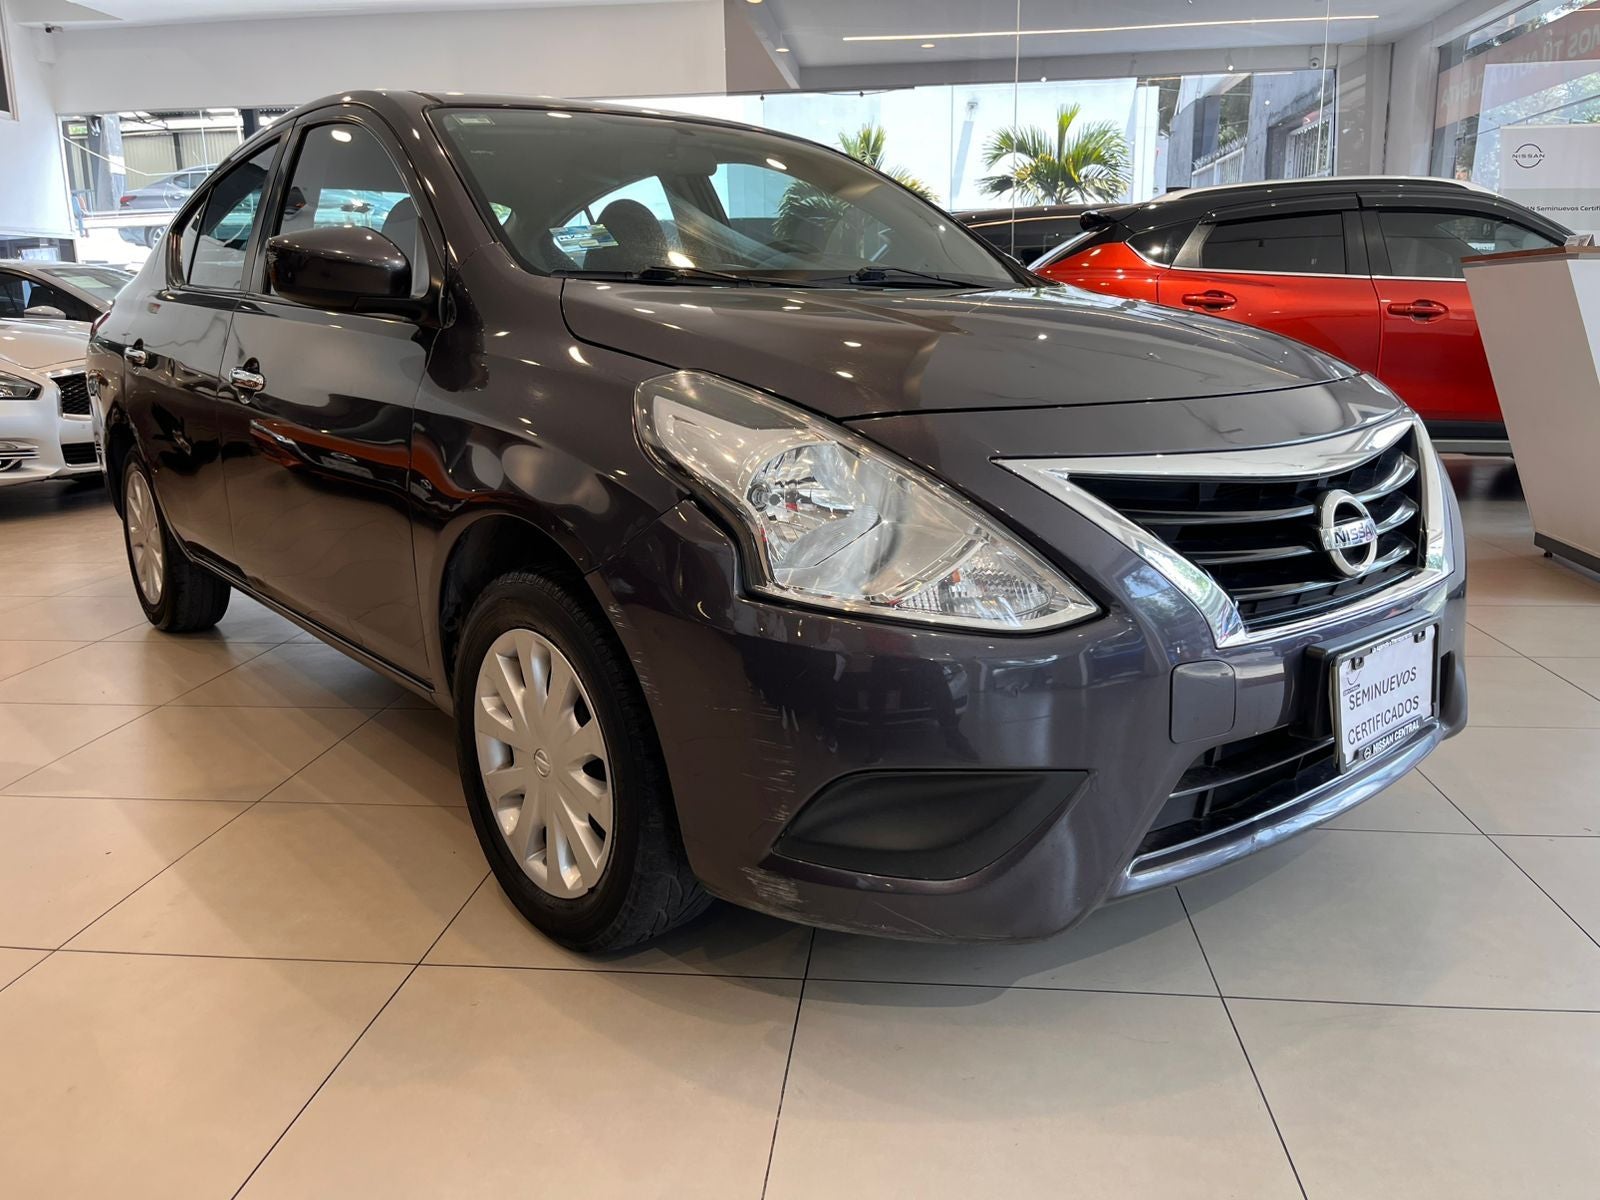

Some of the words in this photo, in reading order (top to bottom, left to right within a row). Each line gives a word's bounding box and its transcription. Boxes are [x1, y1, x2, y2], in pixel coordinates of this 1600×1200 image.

[1349, 666, 1417, 711] SEMINUEVOS
[1347, 695, 1420, 745] CERTIFICADOS
[1372, 733, 1394, 754] NISSAN
[1394, 719, 1420, 741] CENTRAL
